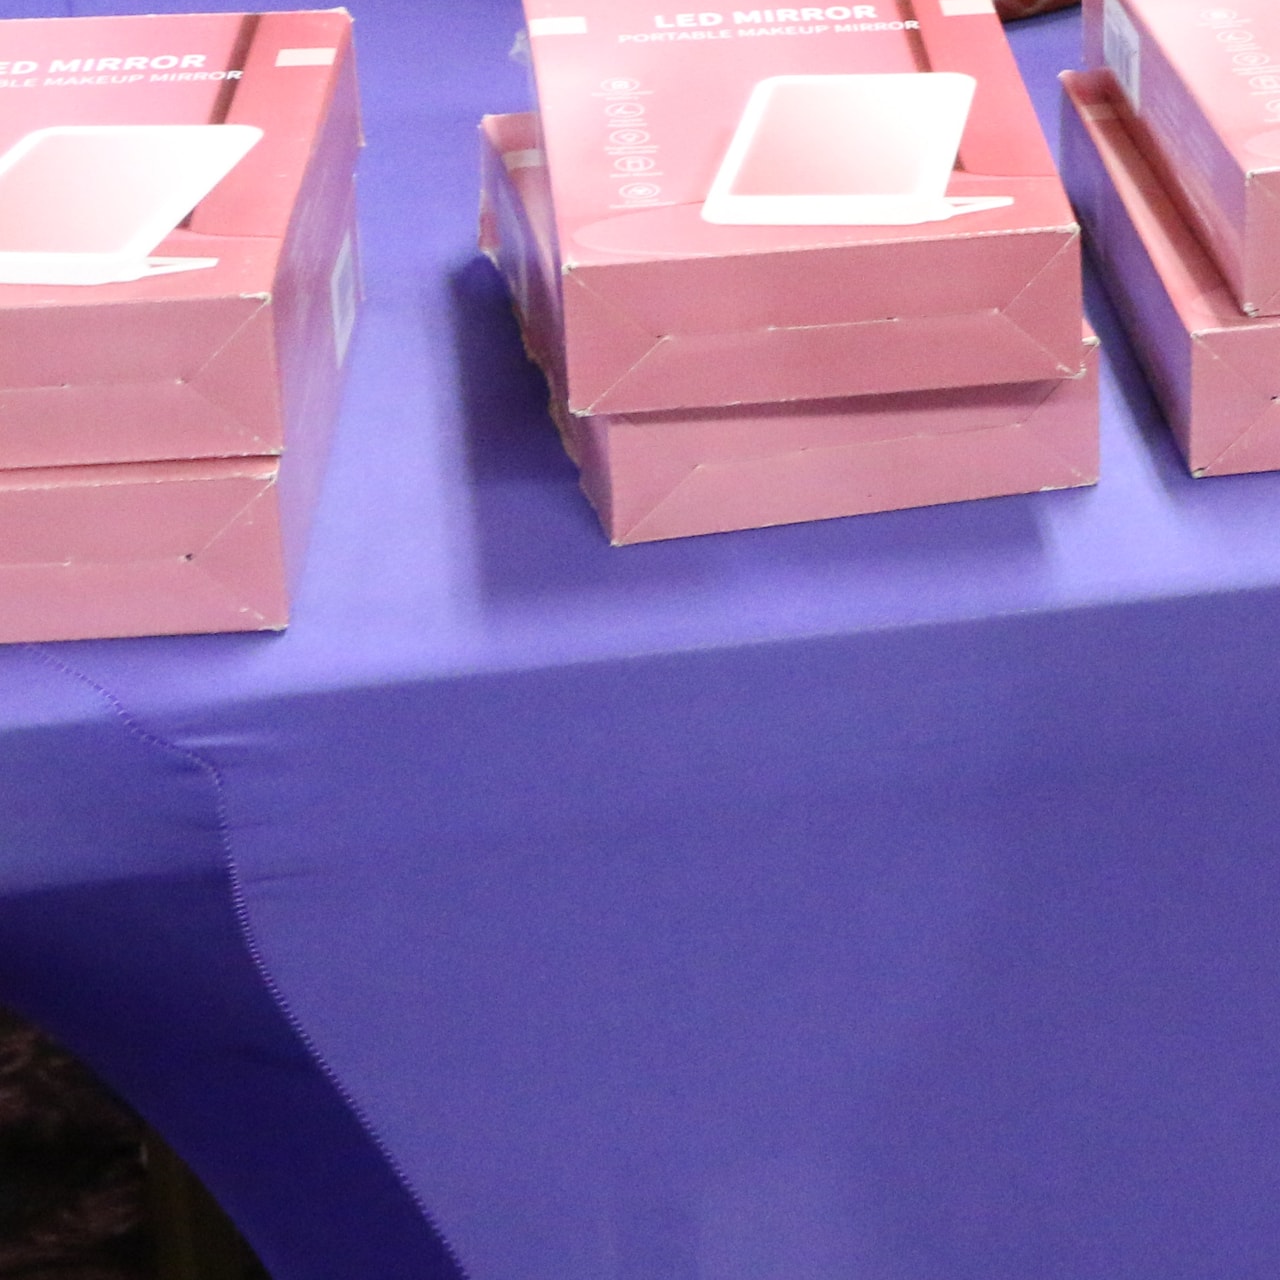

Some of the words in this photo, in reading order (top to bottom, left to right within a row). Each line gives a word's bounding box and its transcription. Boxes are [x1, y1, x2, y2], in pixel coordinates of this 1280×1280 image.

[654, 12, 723, 29] LED
[732, 4, 878, 25] MIRROR
[618, 28, 733, 44] PORTABLE
[738, 24, 830, 38] MAKEUP
[834, 19, 920, 34] MIRROR
[0, 60, 38, 76] ED
[49, 54, 207, 74] MIRROR
[43, 73, 144, 87] MAKEUP
[150, 70, 244, 84] MIRROR
